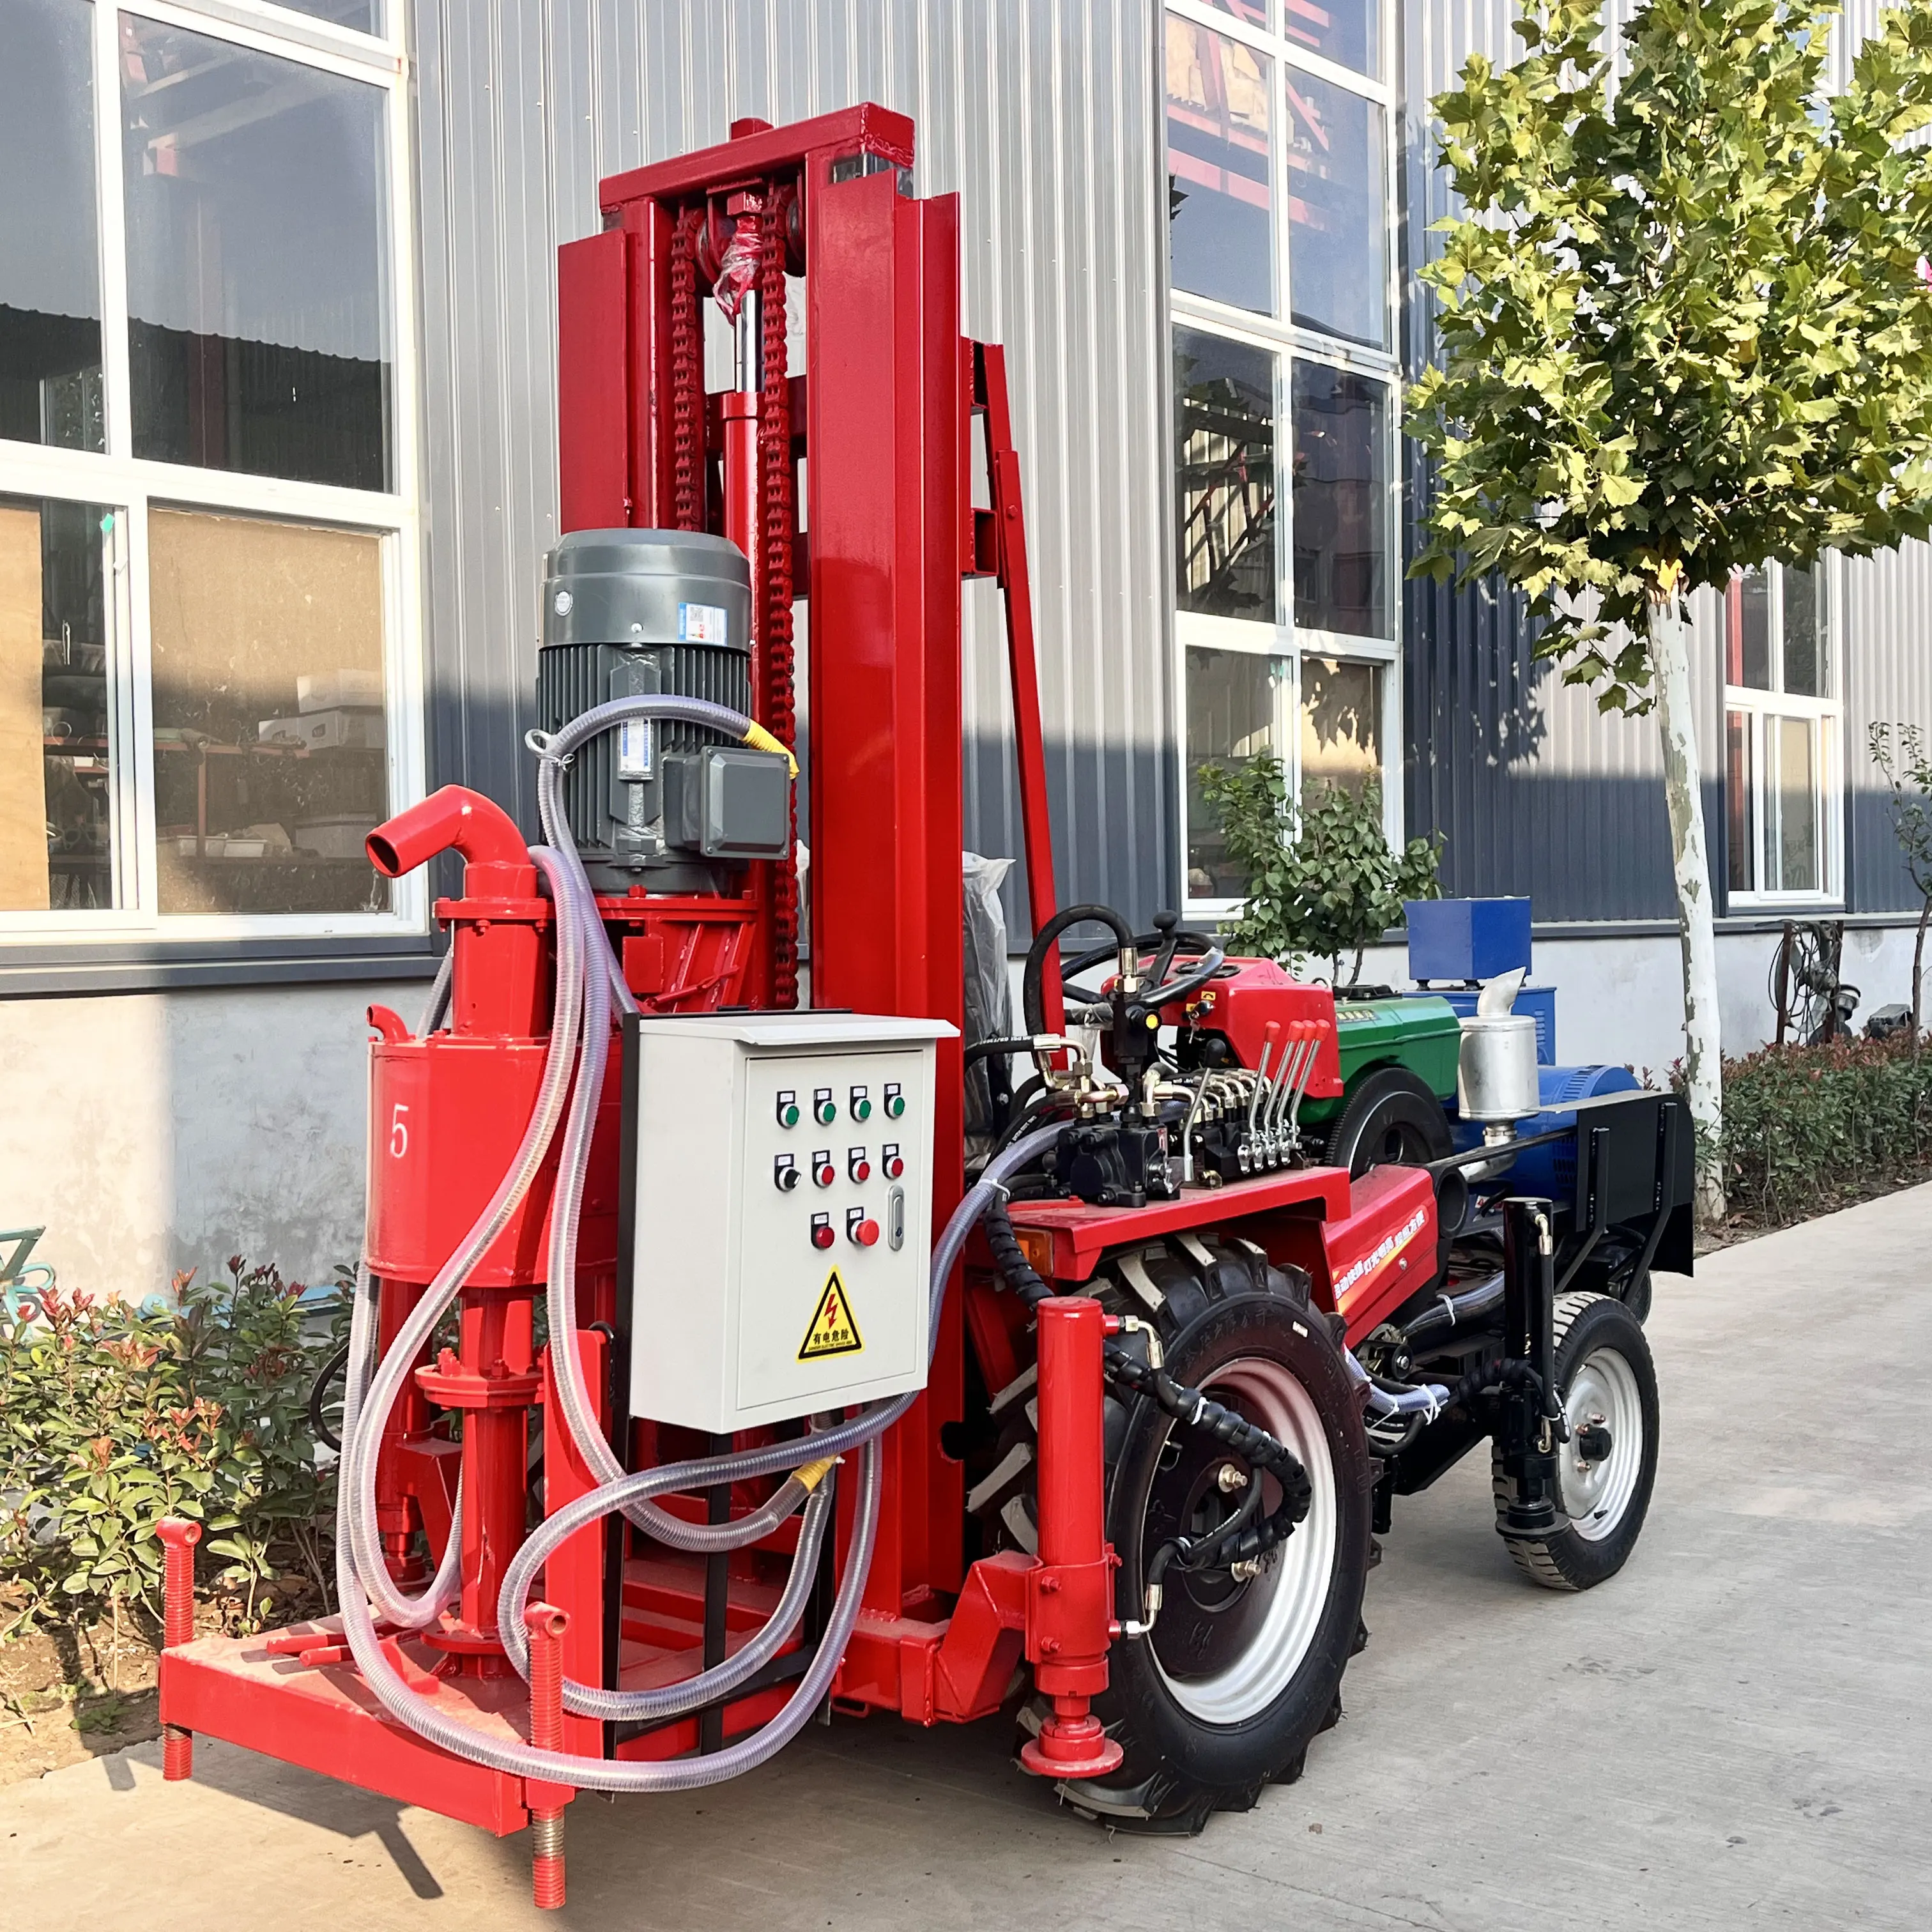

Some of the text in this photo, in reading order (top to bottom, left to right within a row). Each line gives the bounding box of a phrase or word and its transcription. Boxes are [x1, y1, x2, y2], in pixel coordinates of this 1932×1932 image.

[390, 1104, 409, 1158] 5
[813, 1328, 849, 1345] 有电危险
